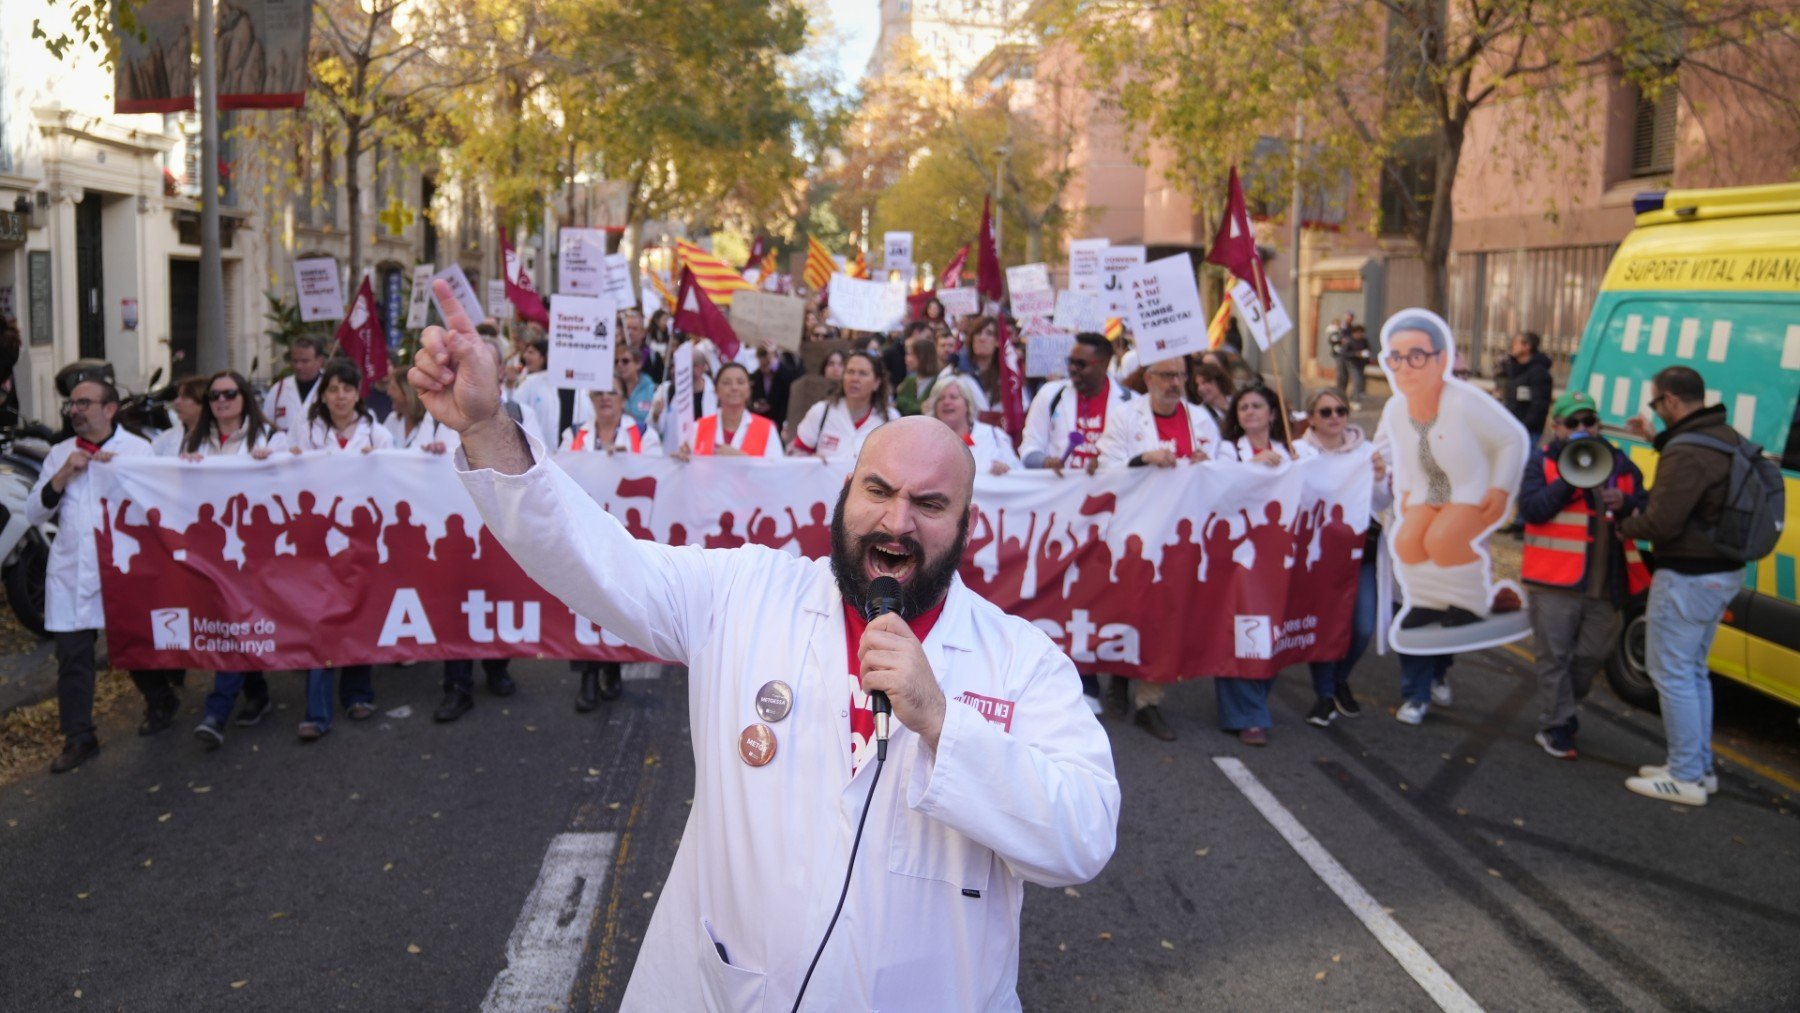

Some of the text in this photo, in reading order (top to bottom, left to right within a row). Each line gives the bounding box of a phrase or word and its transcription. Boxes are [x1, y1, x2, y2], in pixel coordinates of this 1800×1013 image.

[1624, 259, 1688, 282] SUPORT
[1690, 258, 1735, 281] VITAL
[557, 313, 584, 322] Tanta
[193, 617, 276, 638] Metges de
[376, 587, 437, 647] A
[460, 589, 541, 643] tu
[193, 636, 276, 657] Catalunya
